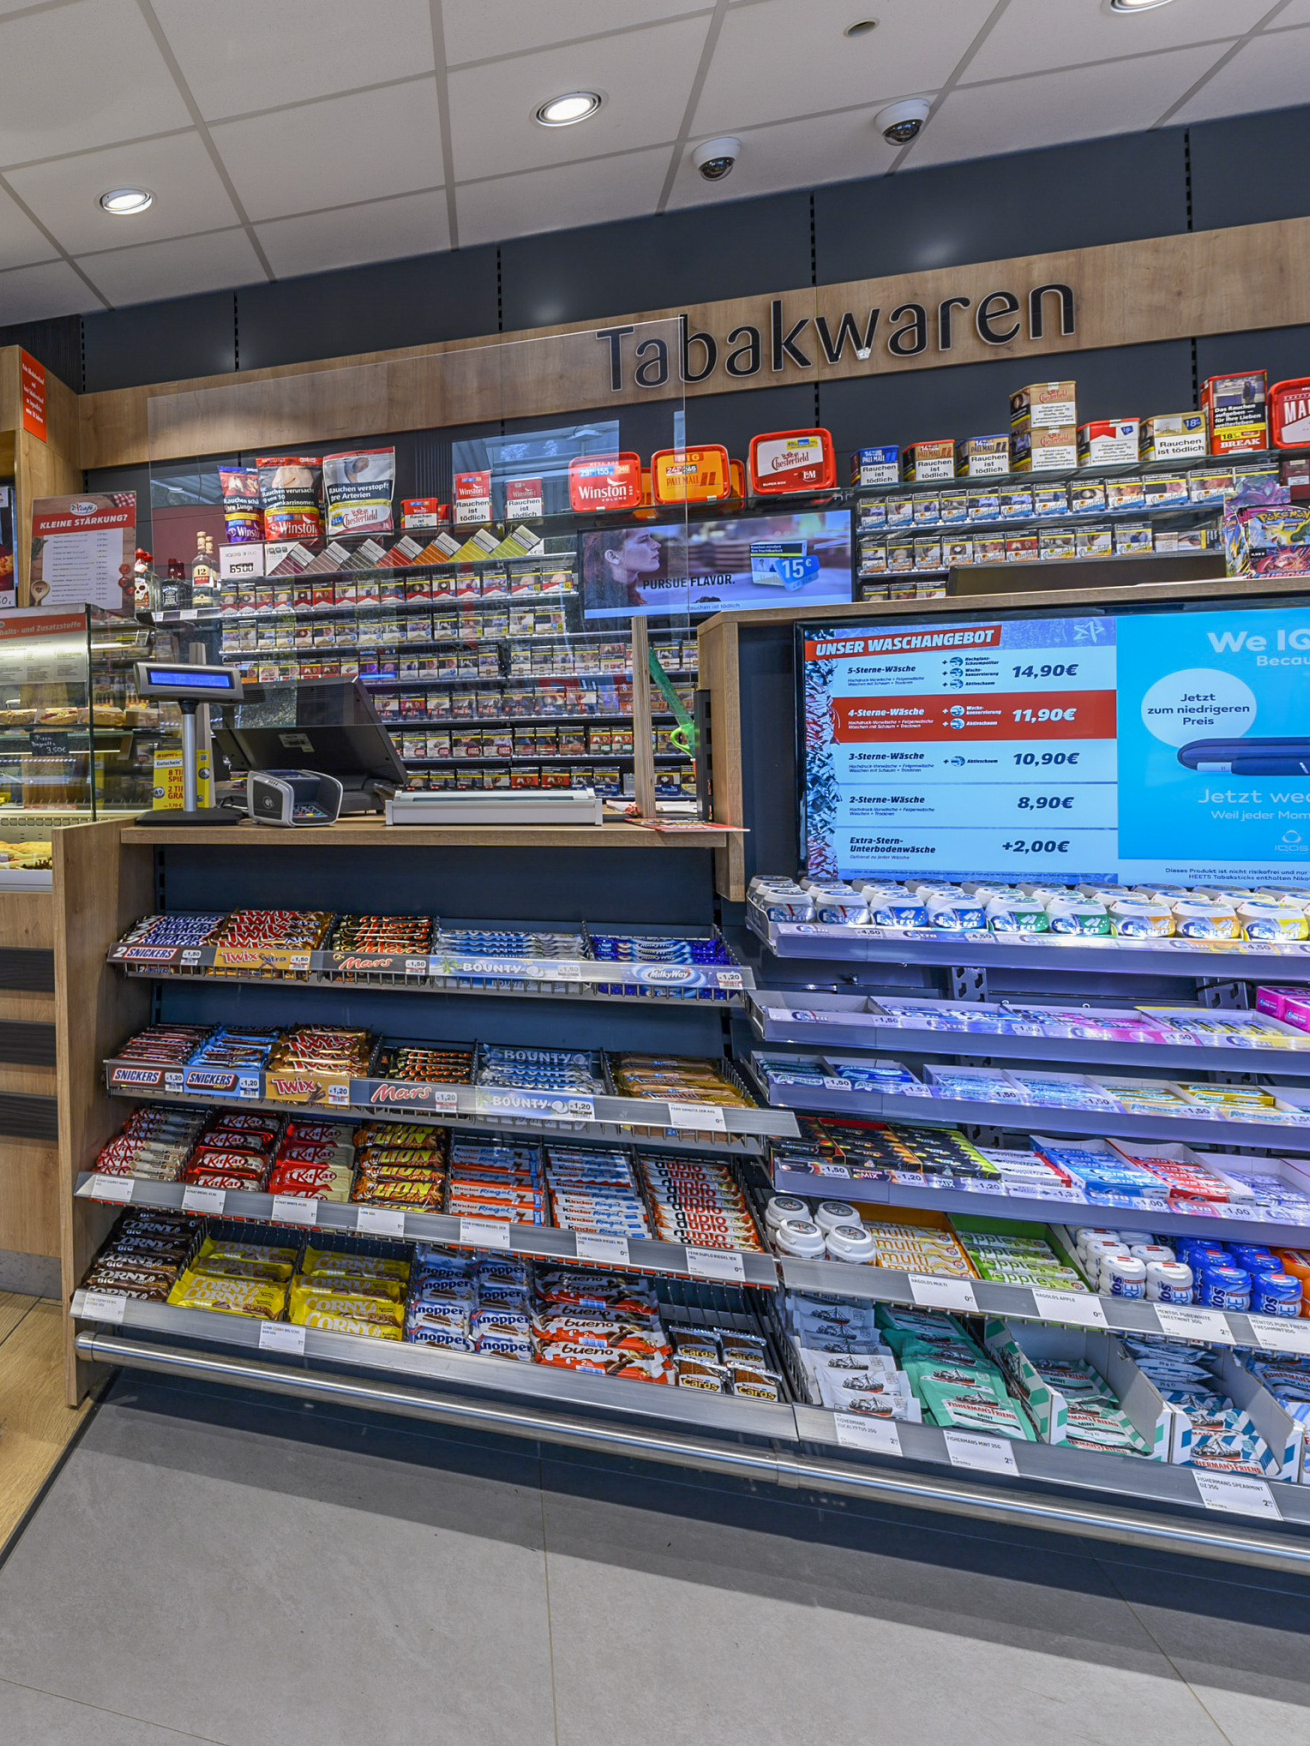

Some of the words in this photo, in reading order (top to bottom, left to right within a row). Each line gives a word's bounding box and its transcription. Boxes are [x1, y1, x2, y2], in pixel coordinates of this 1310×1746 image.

[596, 283, 1077, 392] Tabakwaren
[1157, 448, 1168, 456] ist
[1169, 444, 1205, 454] tödlich
[1159, 438, 1202, 448] Rauchen
[1220, 437, 1261, 449] BREAK
[771, 451, 810, 471] Chesterfield
[918, 459, 952, 468] Rauchen
[971, 454, 1005, 463] Rauchen
[862, 464, 897, 473] Rauchen
[921, 471, 948, 479] tödlich
[975, 465, 1003, 474] tödlich
[866, 476, 893, 484] tödlich
[339, 491, 371, 500] Arterien
[458, 487, 484, 496] Winston
[579, 484, 627, 500] Winston
[456, 500, 490, 508] Rauchen
[39, 519, 72, 530] KLEINE
[73, 514, 128, 526] STÄRKUNG?
[343, 509, 378, 528] Chesterfield
[460, 513, 486, 522] tödlich
[278, 521, 318, 535] Winston
[196, 568, 207, 576] 12
[642, 577, 687, 591] PURSUE
[690, 574, 736, 587] FLAVOR.
[21, 626, 35, 634] und
[36, 620, 82, 632] Zusatzstoffe
[815, 640, 865, 656] UNSER
[867, 629, 995, 652] WASCHANGEBOT
[1206, 630, 1267, 653] We
[847, 665, 916, 674] 5-Sterne-Wäsche
[1012, 663, 1079, 680] 14,90€
[1180, 693, 1217, 702] Jetzt
[847, 708, 925, 717] 4-Sterne-Wäsche
[1012, 707, 1078, 724] 11,90€
[1147, 706, 1174, 715] zum
[1176, 704, 1250, 716] niedrigeren
[1182, 716, 1215, 726] Preis
[848, 752, 925, 761] 3-Sterne-Wäsche
[1013, 752, 1080, 767] 10,90€
[849, 796, 926, 804] 2-Sterne-Wäsche
[1017, 795, 1075, 811] 8,90€
[1197, 788, 1263, 804] Jetzt
[1210, 810, 1239, 820] Weil
[1240, 810, 1275, 822] jeder
[849, 836, 904, 845] Extra-Stern-
[1001, 839, 1070, 855] +2,00€
[849, 845, 936, 854] Unterbodenwäsche
[1248, 868, 1280, 876] risikofrei
[769, 907, 807, 922] Extra
[876, 911, 916, 927] Extra
[1130, 922, 1171, 938] Extra
[112, 946, 128, 958] 2
[126, 947, 176, 959] SNICKERS
[221, 951, 258, 964] Twix
[338, 956, 393, 971] Mars
[461, 962, 523, 974] BOUNTY
[504, 1049, 572, 1064] BOUNTY
[113, 1068, 161, 1084] SNICKERS
[188, 1071, 233, 1087] SNICKERS
[271, 1077, 316, 1095] Twix
[370, 1082, 434, 1103] Mars
[492, 1096, 550, 1110] BOUNTY
[223, 1115, 264, 1129] KitKat
[207, 1132, 244, 1147] KitKat
[302, 1127, 340, 1141] KitKat
[375, 1132, 428, 1144] LION
[207, 1154, 246, 1169] KitKat
[296, 1148, 333, 1162] KitKat
[380, 1150, 433, 1162] LION
[296, 1168, 335, 1185] KitKat
[860, 1172, 879, 1180] MIX
[376, 1182, 433, 1198] LION
[479, 1187, 513, 1197] Riegel
[594, 1201, 622, 1210] Riegel
[675, 1211, 727, 1227] duplo
[123, 1220, 176, 1234] CORNY
[869, 1225, 917, 1241] multi
[875, 1237, 924, 1254] multi
[92, 1267, 150, 1284] CORNY
[96, 1277, 115, 1285] BIG
[184, 1287, 256, 1305] CORNY
[1059, 1295, 1076, 1303] APPLE
[305, 1296, 370, 1314] CORNY
[1157, 1308, 1179, 1317] MENTOS
[1179, 1312, 1212, 1322] PUREWHITE
[1159, 1315, 1191, 1325] SWEETMINT
[305, 1312, 376, 1337] CORNY
[564, 1317, 615, 1329] bueno
[1251, 1319, 1275, 1328] MENTOS
[1274, 1322, 1290, 1330] PURE
[1289, 1323, 1309, 1332] FRESH
[1253, 1324, 1285, 1335] FRESHMINT
[561, 1343, 615, 1357] bueno
[681, 1347, 717, 1360] Cards
[682, 1378, 720, 1392] Cards
[737, 1386, 777, 1401] Cards
[976, 1412, 994, 1421] MINT
[990, 1408, 1018, 1420] FRIEND
[836, 1417, 867, 1427] FISHERMANS
[837, 1423, 868, 1434] EUCALYPTUS
[946, 1435, 979, 1447] FISHERMANS
[977, 1441, 991, 1449] MINT
[1233, 1464, 1263, 1475] FRIEND
[1196, 1476, 1232, 1488] FISHERMANS
[1231, 1482, 1264, 1492] SPEARMINT
